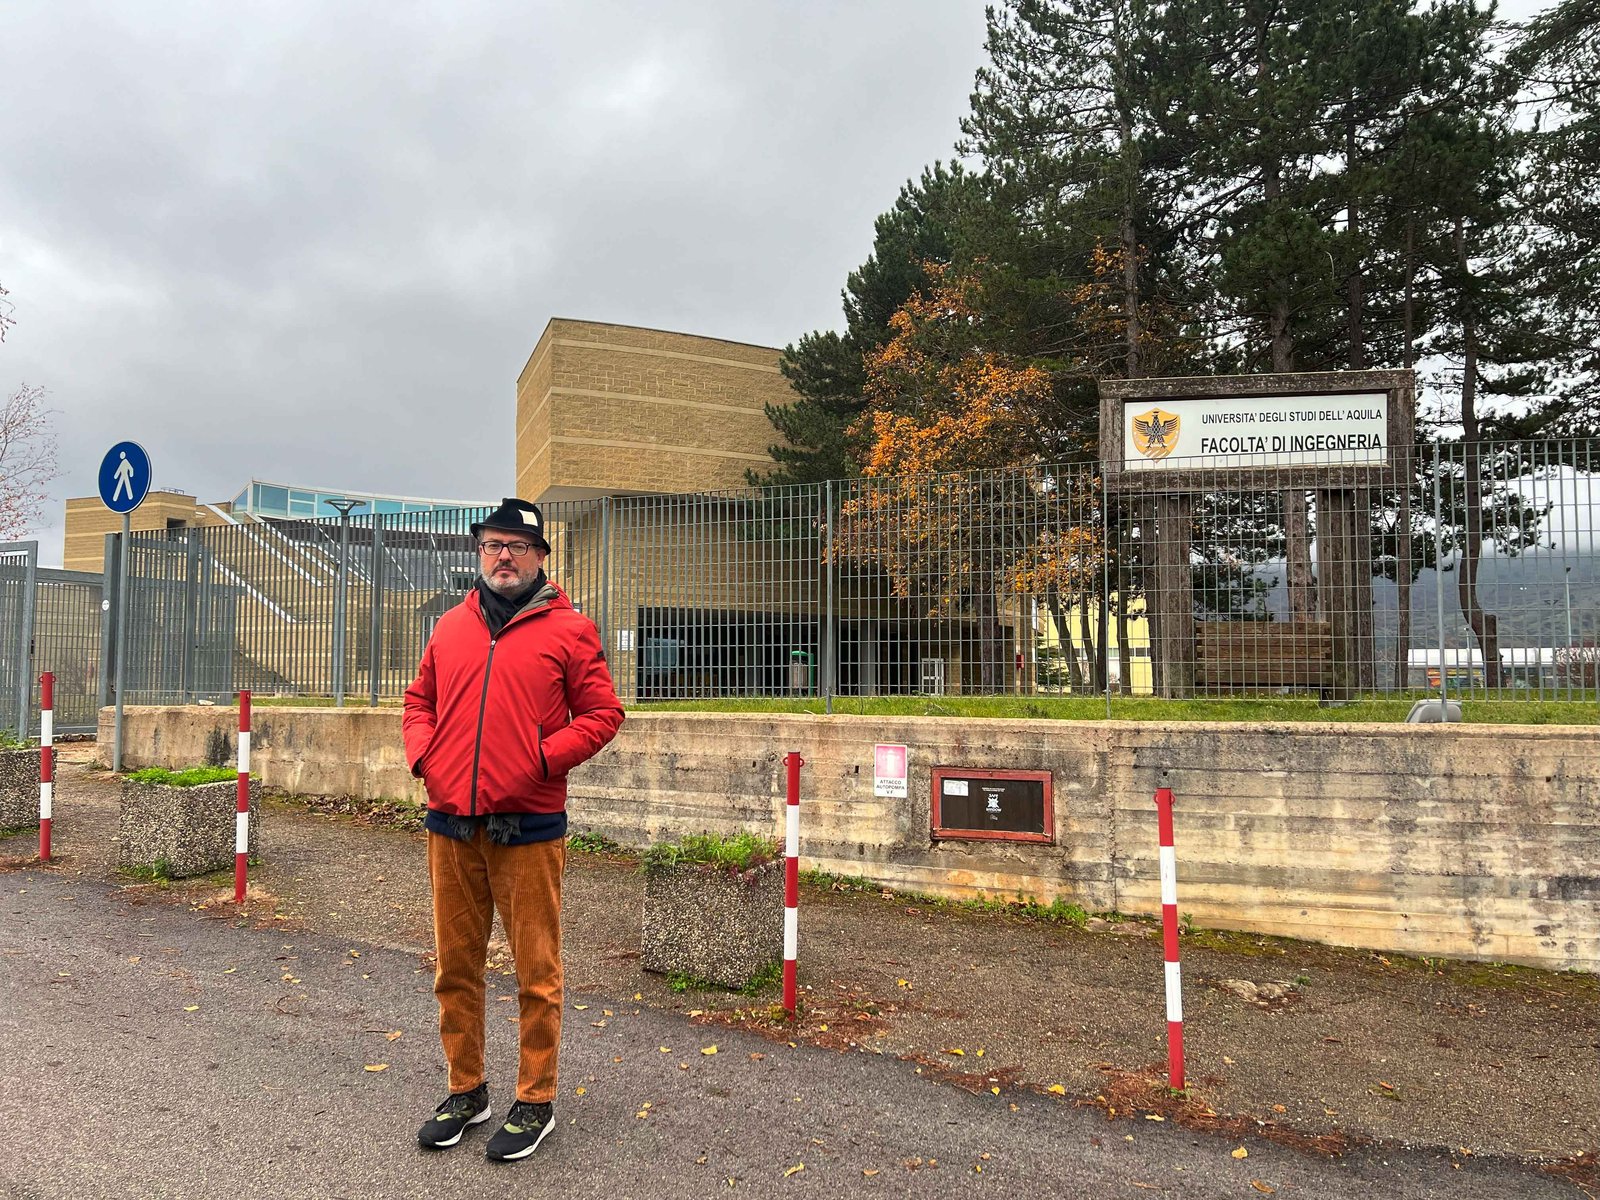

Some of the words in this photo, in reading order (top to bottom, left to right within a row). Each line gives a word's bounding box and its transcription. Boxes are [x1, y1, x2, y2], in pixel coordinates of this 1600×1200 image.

[1202, 413, 1257, 424] UNIVERSITA'
[1259, 412, 1287, 422] DEGLI
[1289, 411, 1317, 421] STUDI
[1201, 436, 1268, 453] FACOLTA'
[1272, 436, 1286, 452] DI
[1290, 434, 1382, 452] INGEGNERIA
